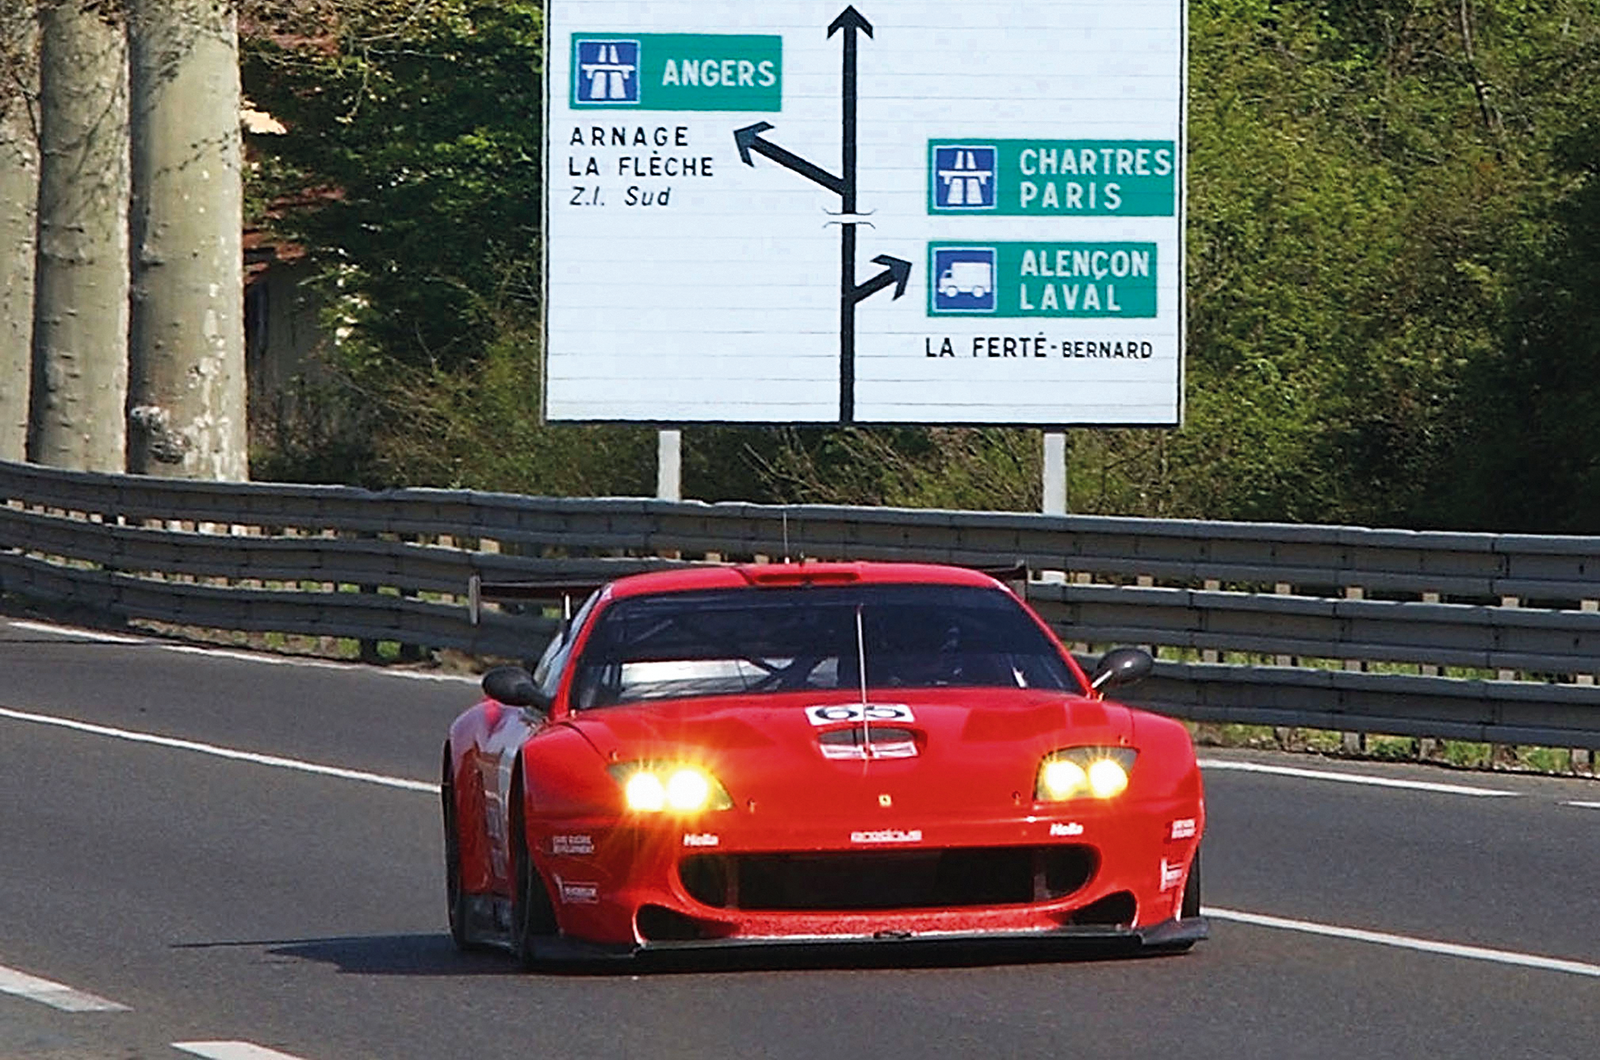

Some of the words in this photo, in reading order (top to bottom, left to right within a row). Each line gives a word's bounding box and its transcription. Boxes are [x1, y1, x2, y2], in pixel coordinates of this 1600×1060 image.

[662, 59, 776, 87] ANGERS
[569, 126, 689, 147] ARNAGE
[569, 156, 600, 176] LA
[618, 150, 714, 177] FLÈCHE
[1019, 147, 1173, 176] CHARTRES
[624, 186, 671, 207] Sud
[1019, 181, 1122, 209] PARIS
[1020, 249, 1150, 280] ALENÇON
[1019, 282, 1122, 311] LAVAL
[925, 337, 956, 358] LA
